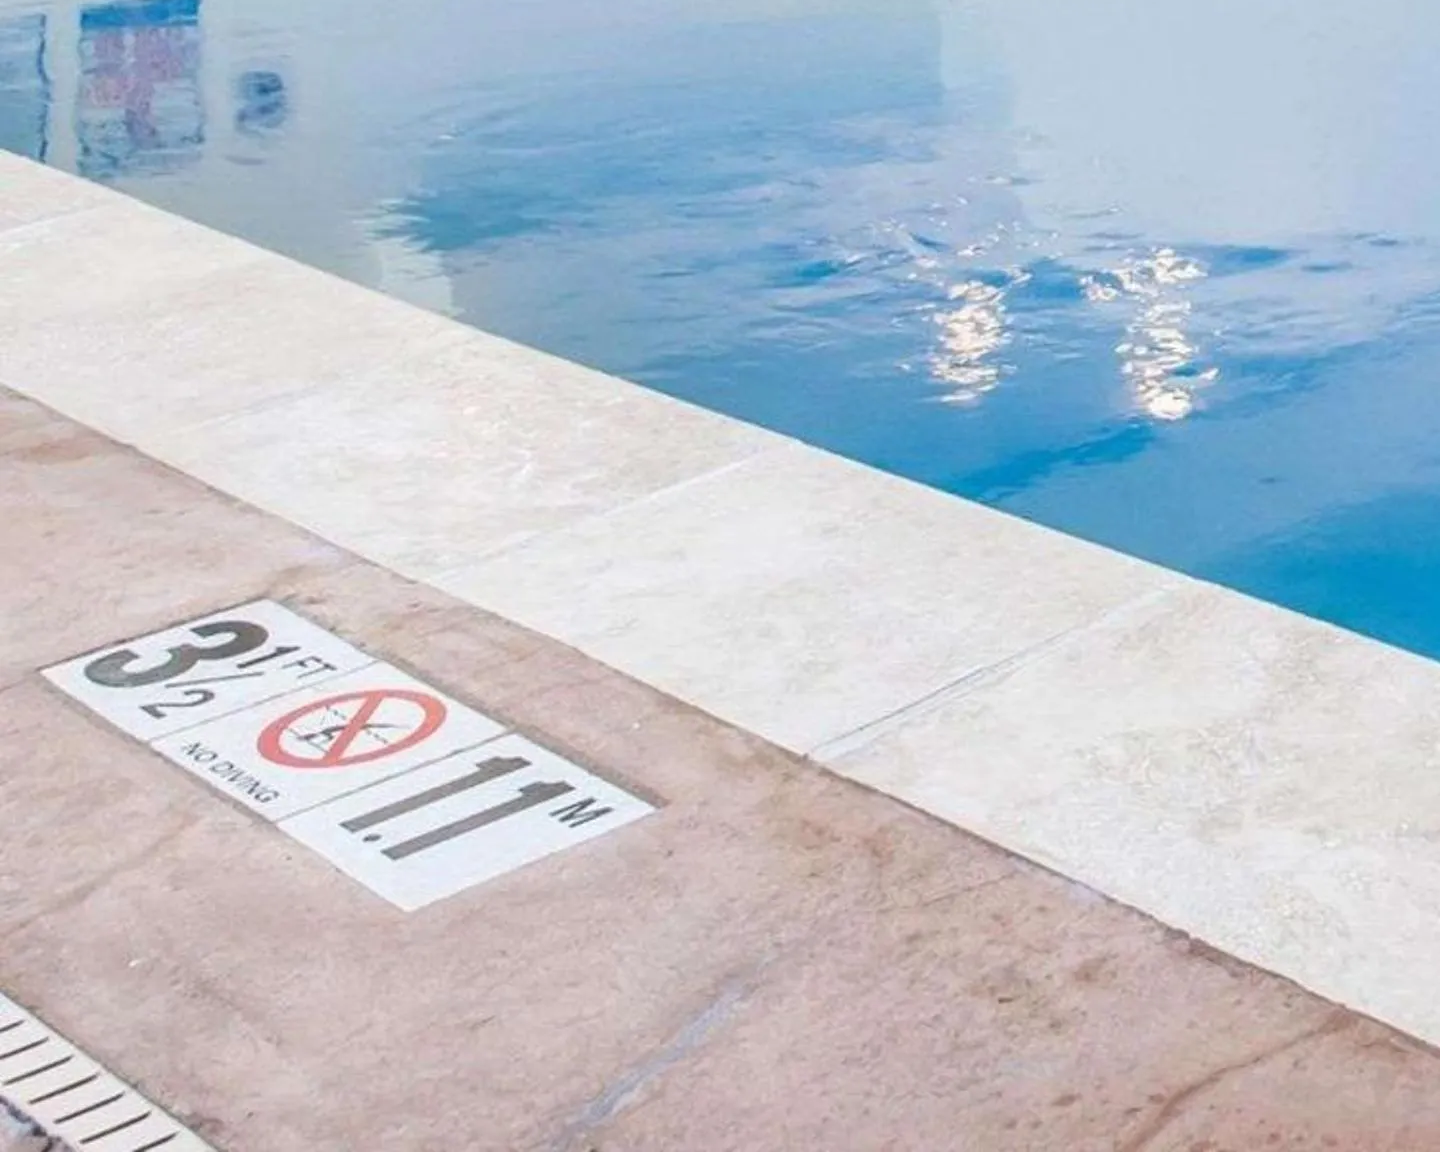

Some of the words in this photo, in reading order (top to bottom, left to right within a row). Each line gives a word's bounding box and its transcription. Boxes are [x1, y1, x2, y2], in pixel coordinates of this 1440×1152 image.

[83, 619, 270, 689] 3
[282, 655, 337, 678] FT
[181, 741, 218, 762] NO
[209, 760, 280, 804] DIVING
[548, 797, 614, 828] M
